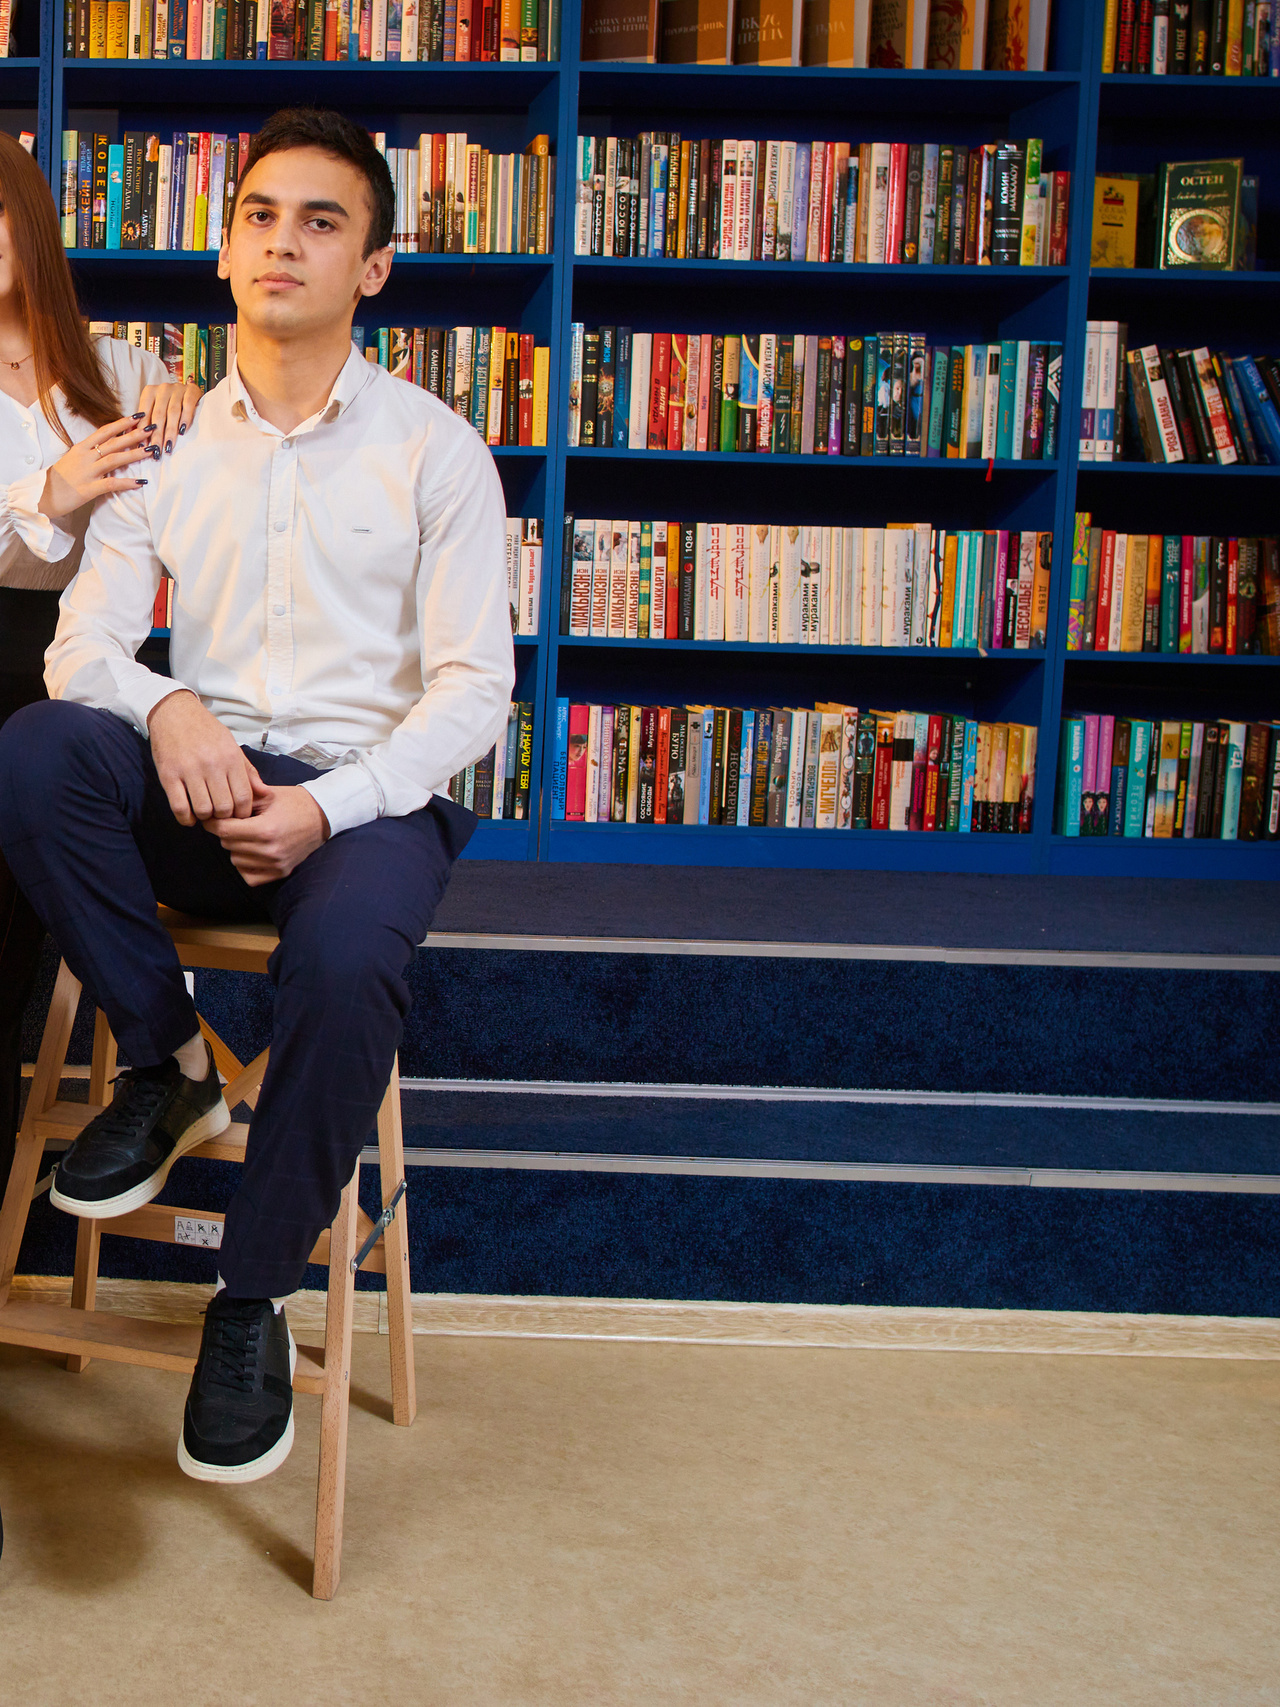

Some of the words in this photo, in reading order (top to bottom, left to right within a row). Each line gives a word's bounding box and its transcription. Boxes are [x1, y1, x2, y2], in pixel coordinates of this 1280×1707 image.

[95, 7, 104, 48] КАССЛЕР
[115, 8, 124, 48] КАССЛЕР
[97, 138, 107, 200] КОБЕН
[770, 144, 778, 169] АНЖЕЛА
[80, 180, 90, 214] КЕЙН
[740, 179, 750, 215] МАКЛИН
[768, 170, 778, 202] МАРСОНС
[812, 155, 822, 207] МИСИМА
[1001, 172, 1009, 204] КОЛИН
[1009, 164, 1018, 212] МАККАЛОУ
[1180, 174, 1224, 186] ОСТЕН
[654, 192, 665, 231] МАРКЛУНД
[724, 183, 734, 215] МАКЛИН
[723, 218, 732, 250] ЧАРЛЬЗ
[738, 218, 748, 251] ЧАРЛЬЗ
[766, 206, 774, 234] КРОВНЫЕ
[812, 208, 820, 245] ЮКИО
[653, 233, 663, 250] ЛИЗА
[765, 235, 774, 255] УЗЫ
[457, 344, 465, 373] МОРЕ
[764, 337, 773, 362] АНЖЕЛА
[866, 354, 874, 372] МЕГАН
[430, 349, 439, 392] КАМЕННАЯ
[714, 353, 722, 390] ДОРОГА
[762, 363, 772, 394] МАРСОНС
[1033, 356, 1044, 390] ТАНЕЦ
[865, 374, 874, 403] МИРАНДА
[760, 398, 769, 446] ИСЧЕЗНУВШИЕ
[1029, 391, 1040, 439] ТЮЛЬПАНОВ
[1158, 396, 1174, 429] ПЛАНАС
[1165, 431, 1177, 452] РОЗА
[1104, 535, 1112, 554] жена
[654, 566, 664, 611] МАККАРТИ
[998, 552, 1006, 596] ПОСЛЕДНИЙ
[1102, 555, 1111, 592] любимая
[571, 574, 589, 628] МАКЬЮЭН
[592, 574, 606, 628] МАКЬЮЭН
[611, 575, 626, 628] МАКЬЮЭН
[628, 575, 639, 630] МАКЬЮЭН
[801, 584, 810, 631] мураками
[810, 583, 820, 632] мураками
[903, 587, 912, 635] мураками
[1100, 594, 1108, 606] Моя
[654, 614, 664, 629] КИТ
[995, 599, 1004, 636] СВИДЕТЕЛЬ
[647, 713, 655, 748] Мукерджи
[671, 732, 679, 760] БУРЮ
[521, 734, 531, 766] НАЙДУ
[617, 740, 628, 774] ТЬМА
[757, 741, 768, 761] ЕСЛИ
[520, 770, 530, 789] ТЕБЯ
[552, 761, 560, 800] ПАЦИЕНТ
[755, 763, 767, 795] АНГЕЛЫ
[806, 765, 816, 797] ВООБРАЗИ
[820, 765, 836, 814] МИТЧЕЛЛ
[754, 797, 766, 823] ПАДУТ
[805, 799, 814, 817] МЕНЯ
